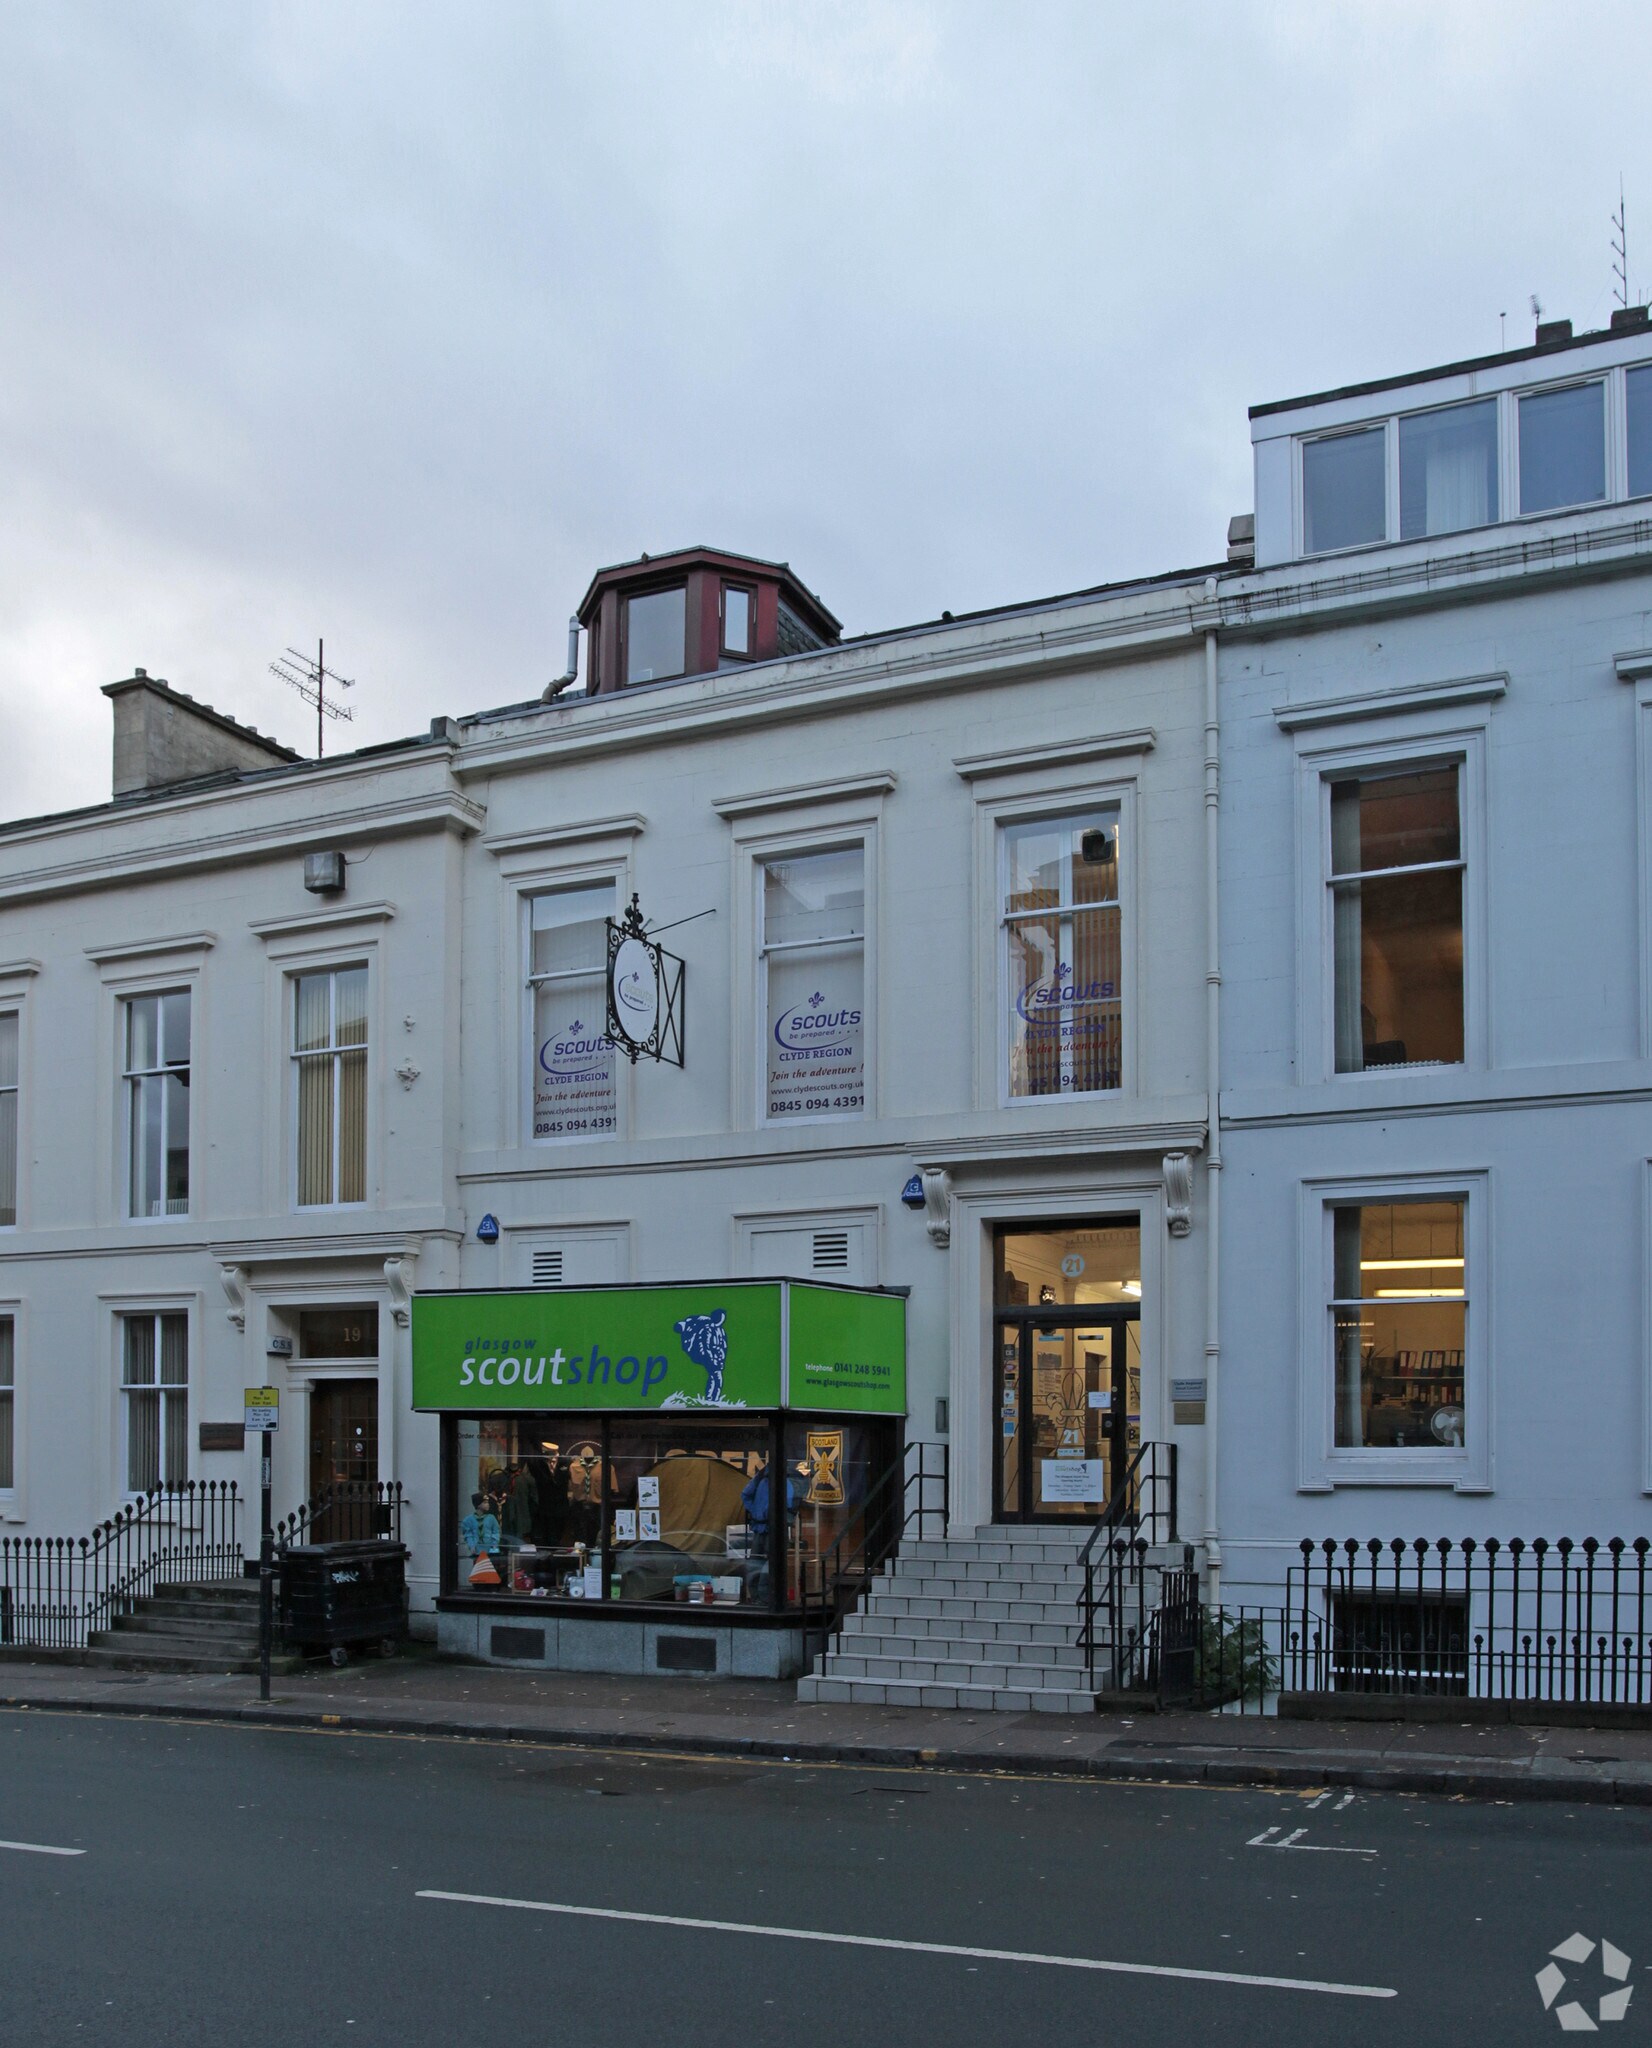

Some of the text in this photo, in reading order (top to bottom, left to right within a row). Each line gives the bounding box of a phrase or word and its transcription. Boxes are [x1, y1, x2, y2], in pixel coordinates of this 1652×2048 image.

[1035, 980, 1114, 1003] scouts
[791, 1009, 861, 1031] scouts
[789, 1032, 798, 1040] be
[800, 1029, 835, 1040] prepared
[1023, 1023, 1105, 1040] CLYDE REGION
[554, 1036, 615, 1056] scouts
[1037, 1043, 1052, 1055] the
[1056, 1041, 1108, 1052] adventure
[562, 1055, 593, 1064] prepared
[779, 1047, 853, 1061] CLYDE REGION
[544, 1072, 609, 1085] CLYDE REGION
[770, 1071, 789, 1083] Join
[792, 1069, 806, 1078] the
[810, 1066, 857, 1077] adventure
[1053, 1074, 1079, 1087] 094
[770, 1080, 864, 1095] www.clydescouts.org.uk
[535, 1089, 611, 1105] Join the adventure
[770, 1095, 864, 1113] 0845 094 4391
[535, 1117, 616, 1133] 0845 094 4391
[1066, 1257, 1082, 1273] 21
[343, 1327, 361, 1342] 19
[464, 1336, 537, 1355] glasgow
[459, 1345, 669, 1397] scoutshop
[805, 1363, 891, 1376] telephone 0141 248 5941
[805, 1378, 891, 1390] www.glasgowscoutshop.com
[811, 1438, 838, 1446] SCOTLAND
[1063, 1429, 1079, 1444] 21
